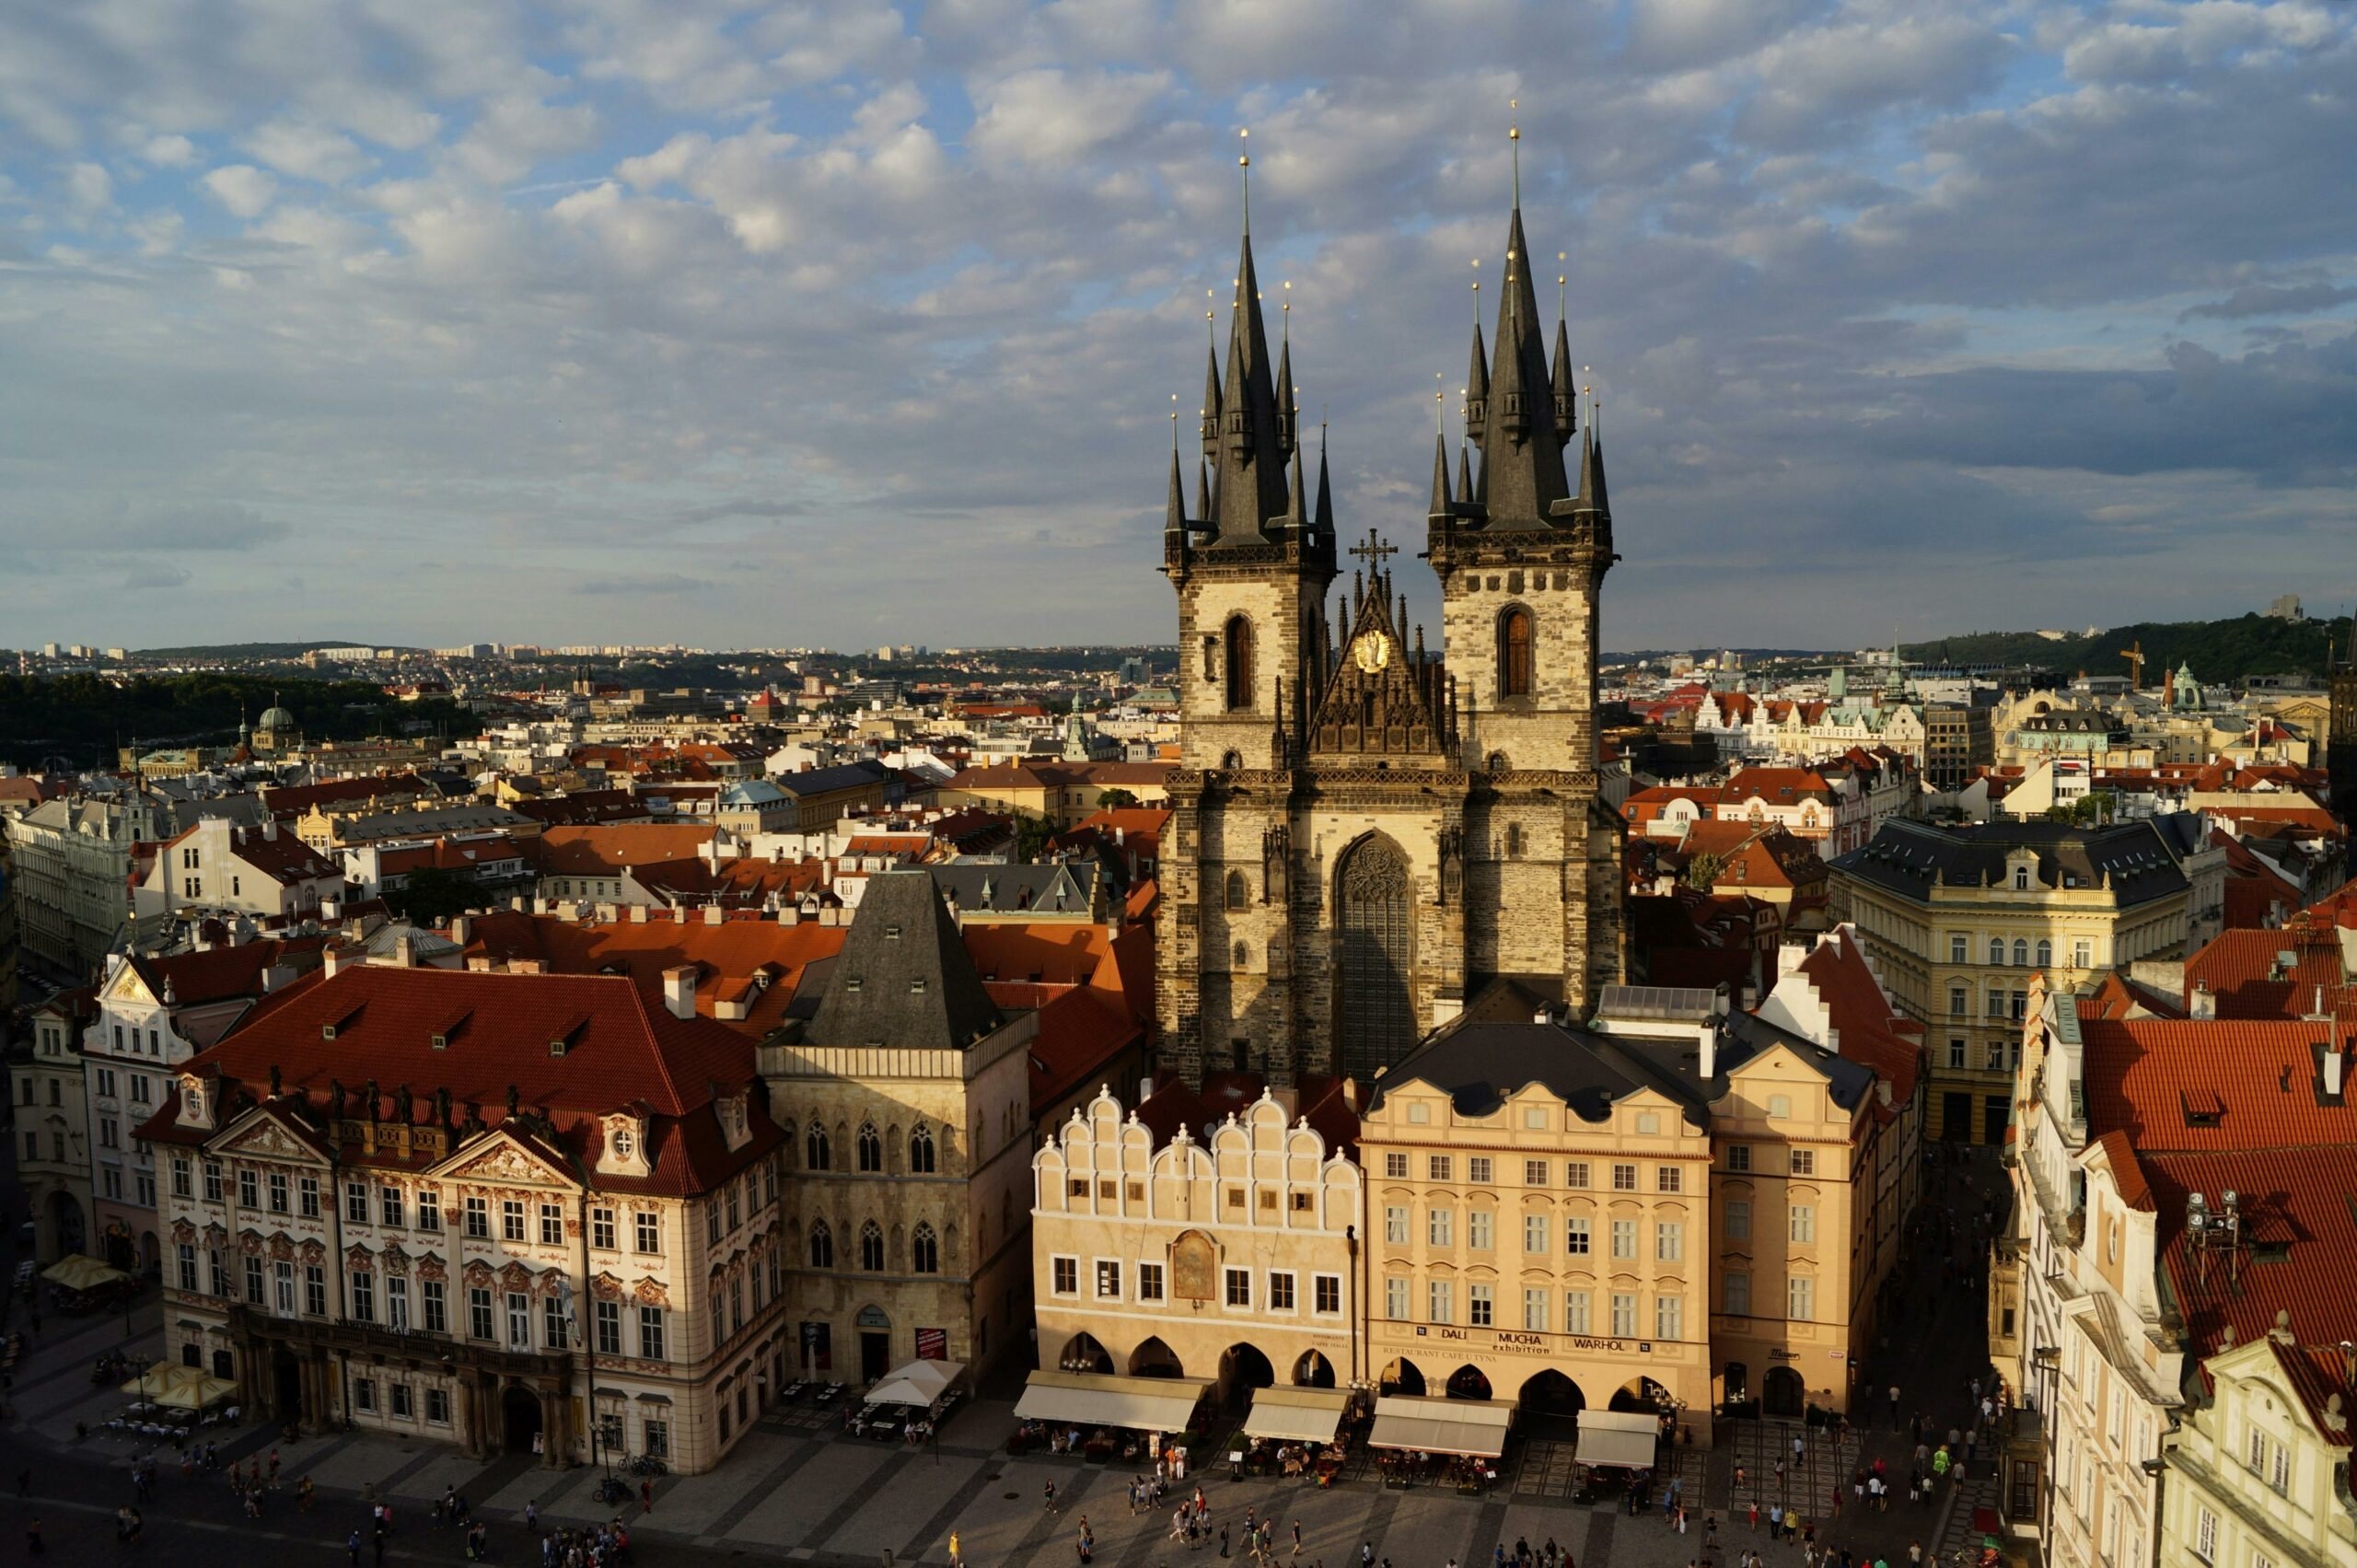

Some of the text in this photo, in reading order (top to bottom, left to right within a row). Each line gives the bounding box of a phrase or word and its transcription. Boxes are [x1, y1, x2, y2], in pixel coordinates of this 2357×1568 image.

[1498, 1333, 1541, 1345] MUCHA
[1573, 1338, 1625, 1352] WARHOL
[1383, 1347, 1440, 1358] RESTAURANT
[1492, 1344, 1550, 1354] exhibition
